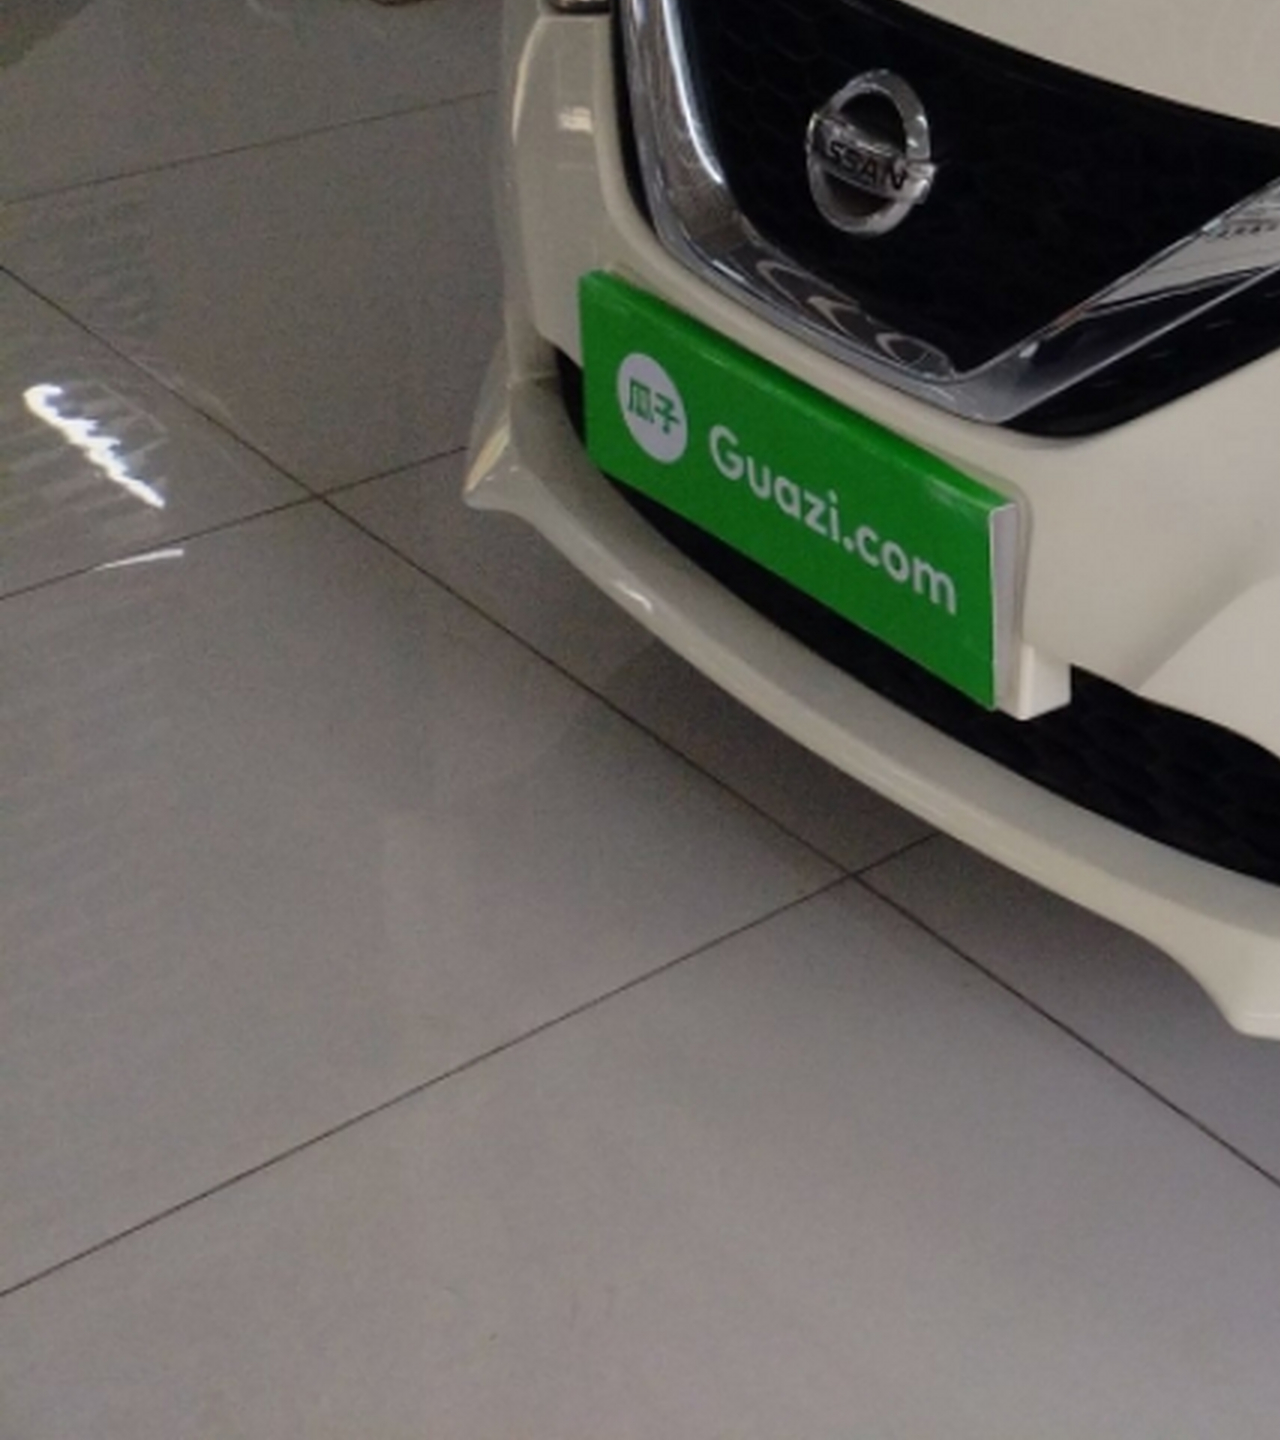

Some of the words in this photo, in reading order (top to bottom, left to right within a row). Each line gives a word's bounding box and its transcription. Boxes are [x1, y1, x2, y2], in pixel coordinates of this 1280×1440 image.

[816, 134, 908, 191] SSAN
[628, 377, 681, 435] 瓜子
[709, 424, 957, 615] Guazi.com
